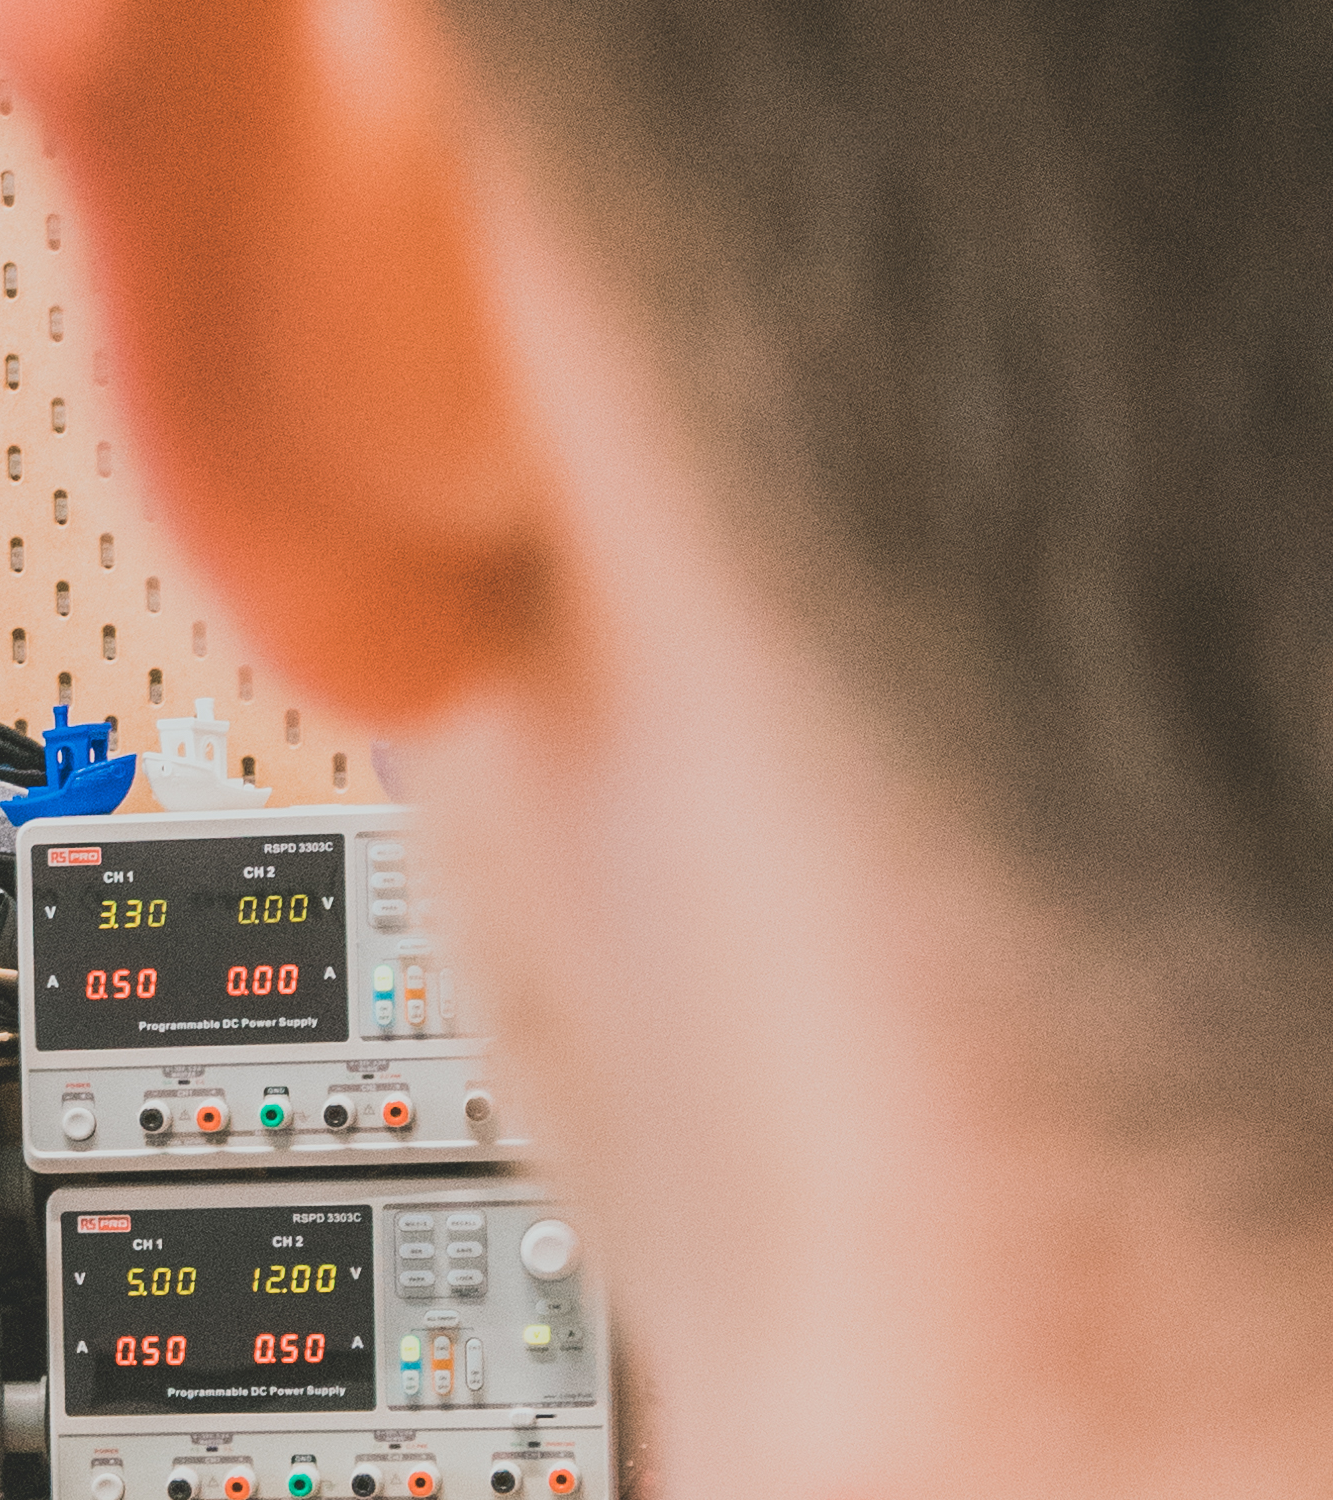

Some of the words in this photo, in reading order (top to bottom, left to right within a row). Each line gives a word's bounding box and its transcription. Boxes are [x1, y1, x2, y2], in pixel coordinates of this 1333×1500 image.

[263, 843, 296, 854] RSPD
[298, 841, 334, 853] 3303C
[69, 851, 99, 863] PRO
[103, 871, 124, 884] CH
[127, 870, 134, 883] 1
[244, 866, 264, 879] CH
[267, 866, 276, 878] 2
[238, 894, 309, 925] 0.00
[322, 897, 334, 910] V
[44, 905, 56, 919] V
[98, 899, 168, 930] 3.30
[323, 966, 337, 980] A
[46, 975, 60, 988] A
[85, 968, 158, 1000] 0.50
[227, 964, 299, 997] 0.00
[138, 1019, 221, 1033] Programmable
[222, 1019, 240, 1030] DC
[241, 1017, 277, 1029] Power
[279, 1016, 319, 1029] Supply
[99, 1218, 129, 1230] PRO
[292, 1213, 325, 1223] RSPD
[326, 1212, 362, 1223] 3303C
[132, 1238, 153, 1250] CH
[156, 1238, 163, 1250] 1
[272, 1235, 293, 1248] CH
[295, 1235, 304, 1247] 2
[74, 1272, 86, 1285] V
[251, 1263, 337, 1294] 12.00
[349, 1267, 362, 1280] V
[126, 1267, 197, 1296] 5.00
[76, 1340, 89, 1354] A
[253, 1332, 326, 1364] 0.50
[351, 1336, 364, 1349] A
[115, 1334, 187, 1366] 0.50
[167, 1386, 249, 1399] Programmable
[250, 1386, 268, 1397] DC
[269, 1385, 305, 1397] Power
[306, 1385, 346, 1398] Supply
